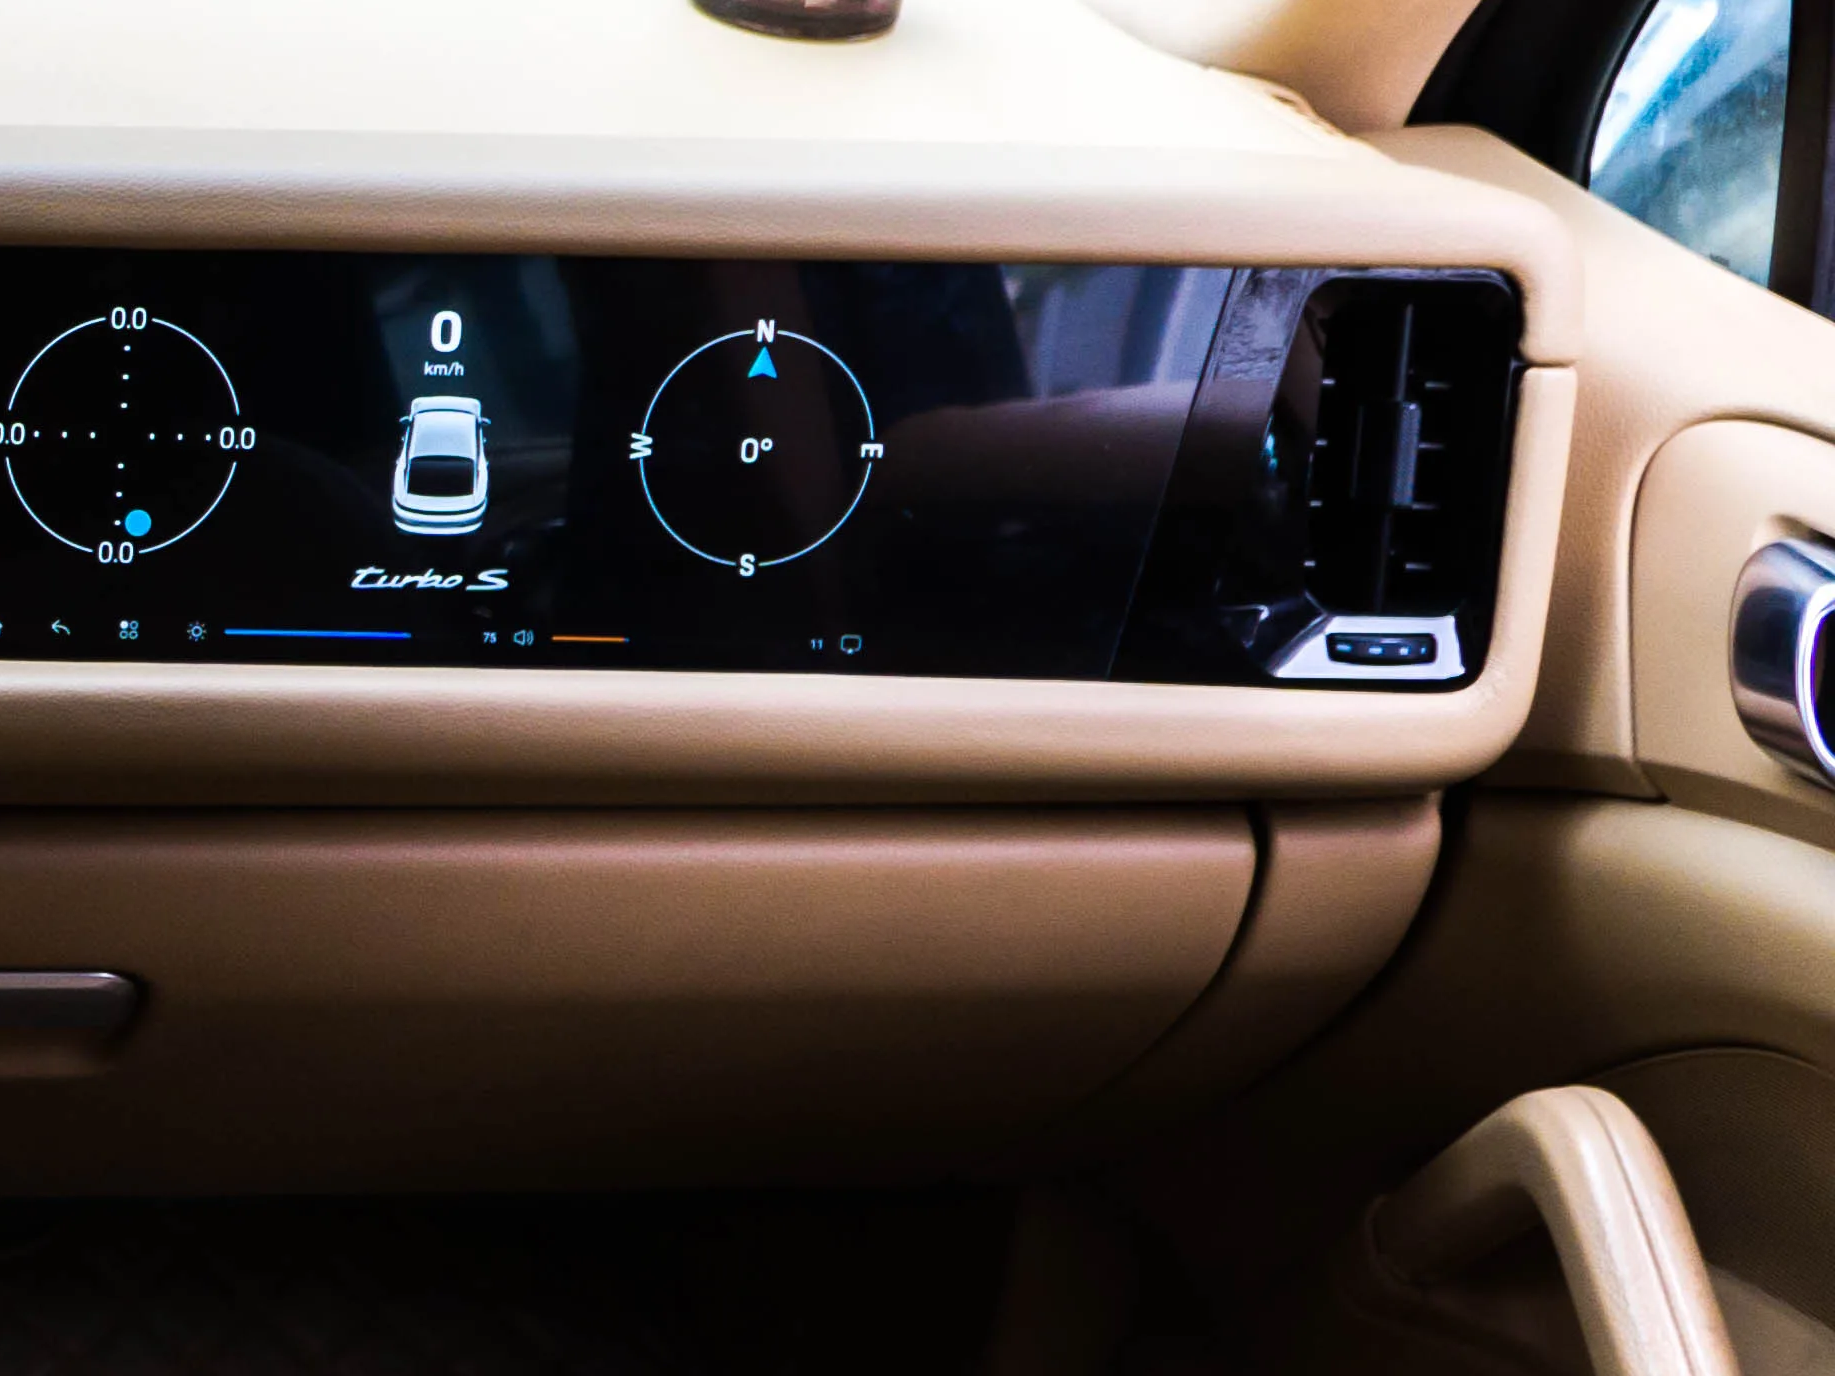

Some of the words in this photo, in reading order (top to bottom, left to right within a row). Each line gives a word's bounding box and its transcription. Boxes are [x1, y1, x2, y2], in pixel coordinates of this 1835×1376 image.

[110, 306, 148, 330] 0.0
[429, 310, 463, 353] 0
[756, 318, 776, 343] N
[423, 361, 465, 376] km/h
[219, 427, 256, 450] 0.0
[629, 433, 654, 460] W
[740, 437, 773, 464] 0°
[860, 442, 885, 459] E
[98, 540, 134, 564] 0.0
[739, 553, 756, 577] S
[465, 569, 509, 591] S
